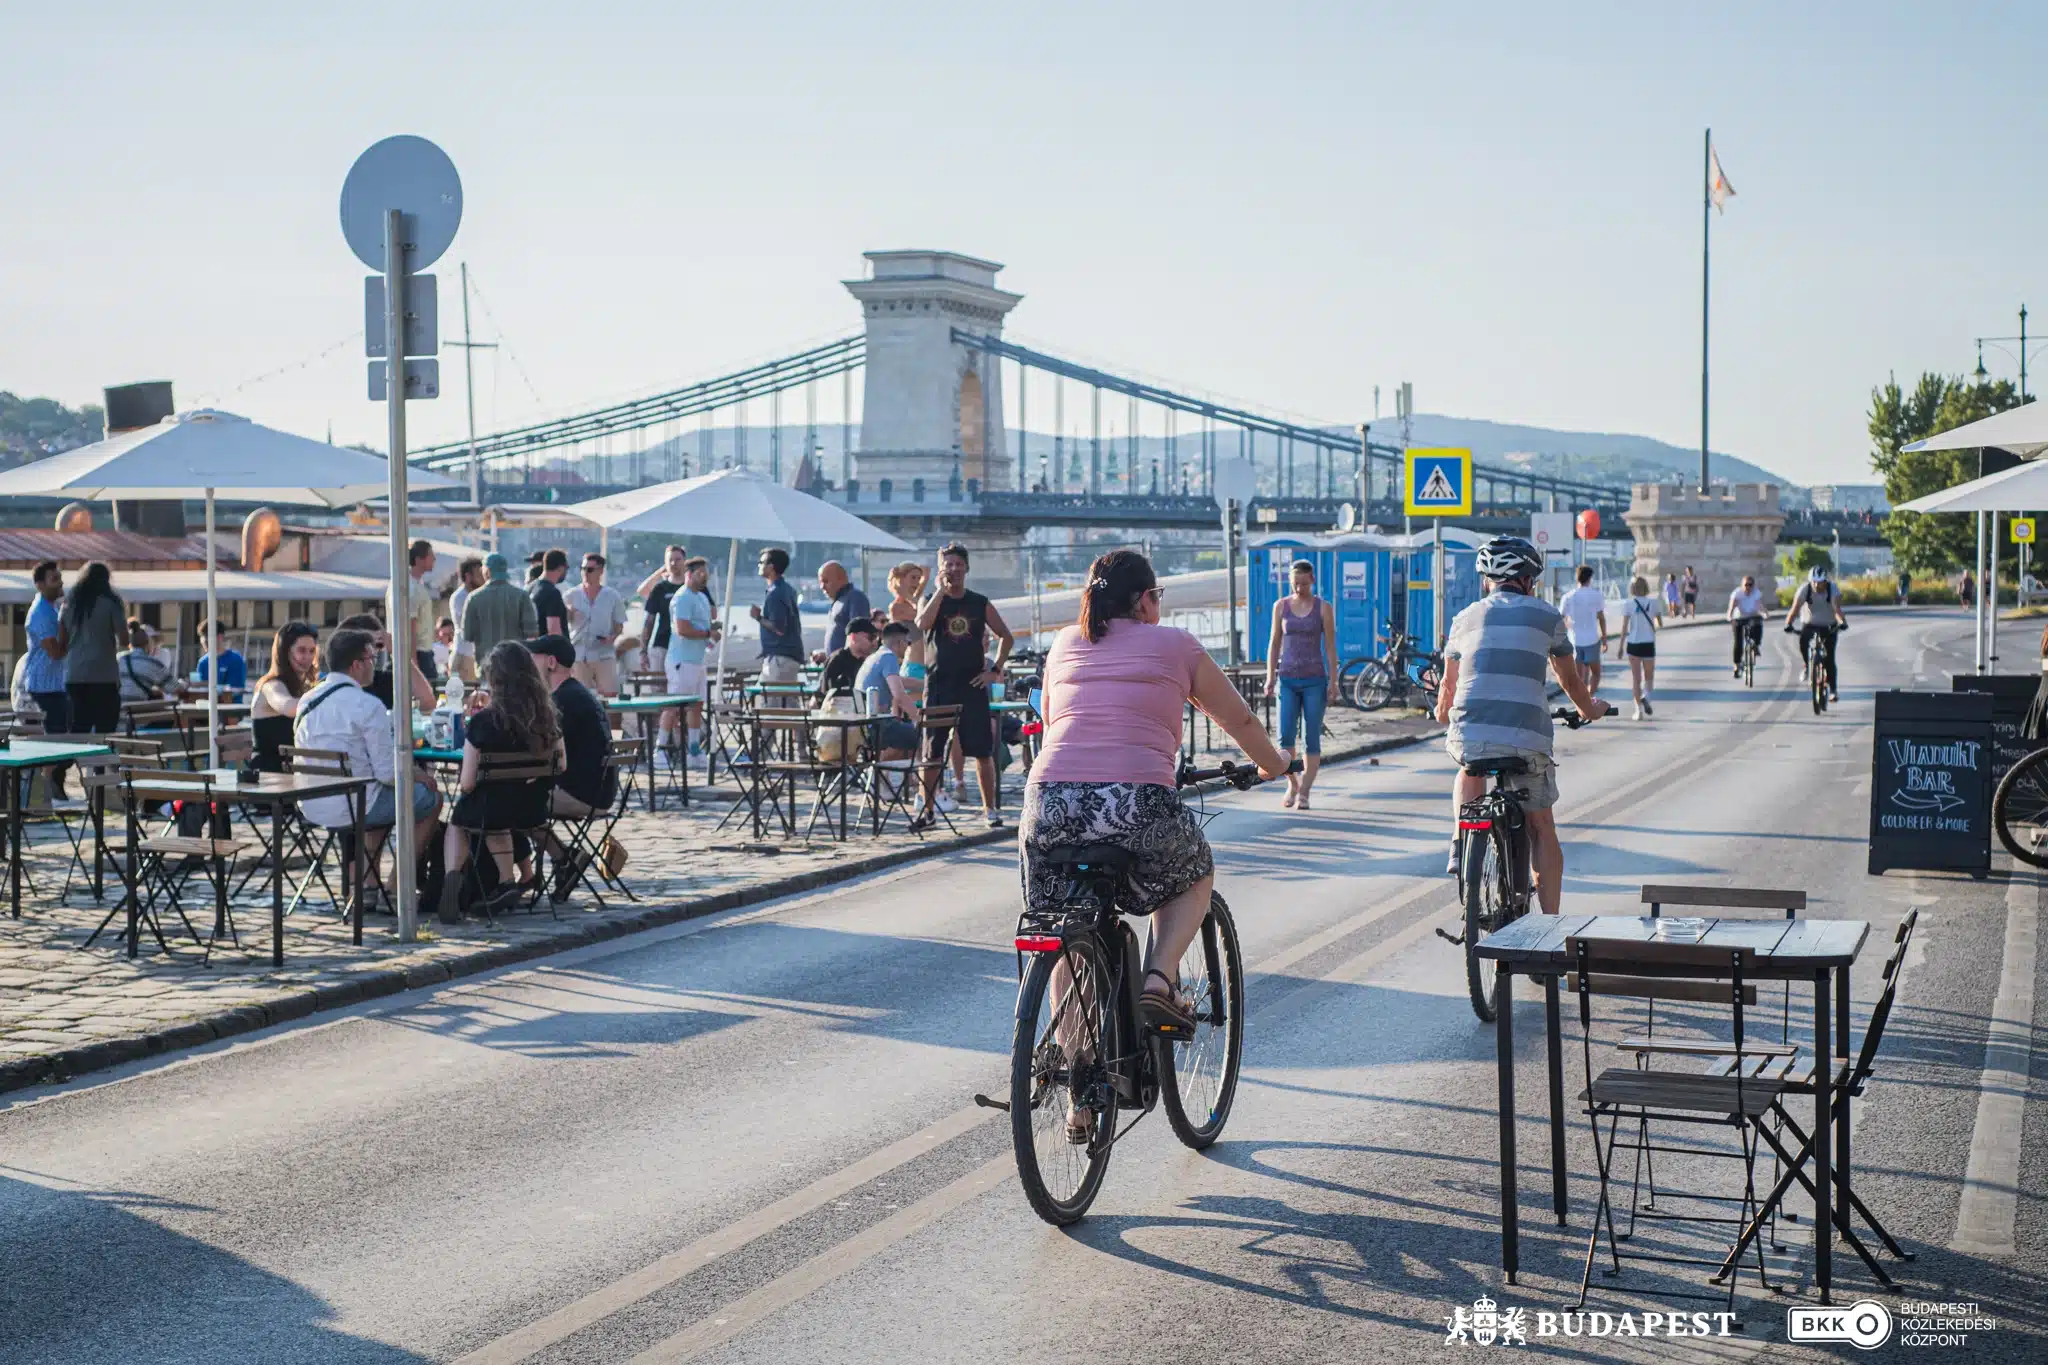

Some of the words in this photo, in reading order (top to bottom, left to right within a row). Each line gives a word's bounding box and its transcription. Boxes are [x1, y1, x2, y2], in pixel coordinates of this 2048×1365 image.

[1906, 766, 1955, 794] BAR
[1881, 814, 1906, 828] COLD
[1906, 815, 1933, 830] BEER
[1935, 816, 1944, 830] &
[1945, 817, 1970, 832] MORE
